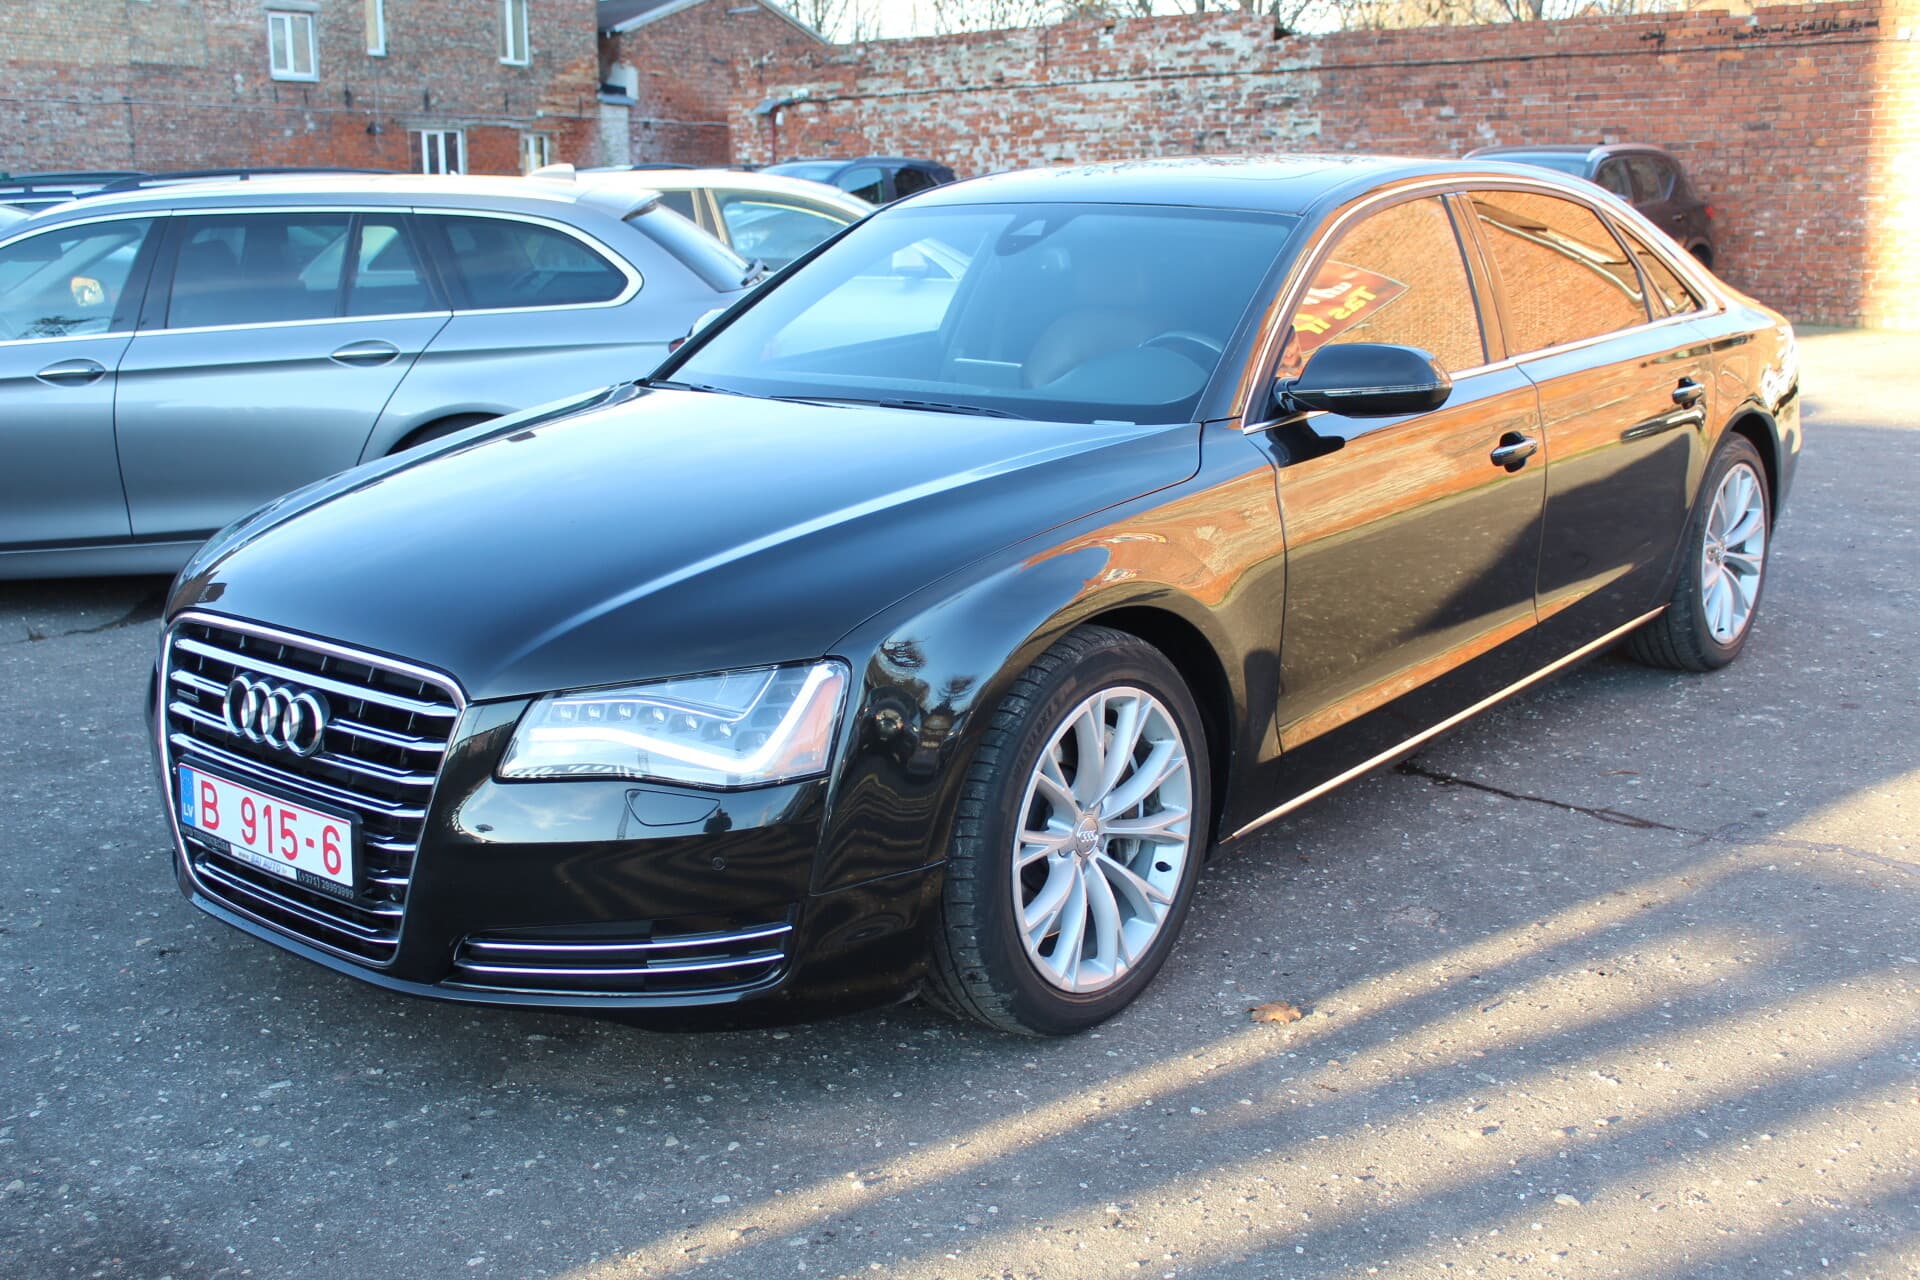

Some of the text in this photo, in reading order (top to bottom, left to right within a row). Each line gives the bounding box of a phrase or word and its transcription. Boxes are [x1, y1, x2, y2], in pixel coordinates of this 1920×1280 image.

[183, 803, 194, 817] LV
[201, 780, 220, 830] B
[240, 796, 342, 876] 915-6
